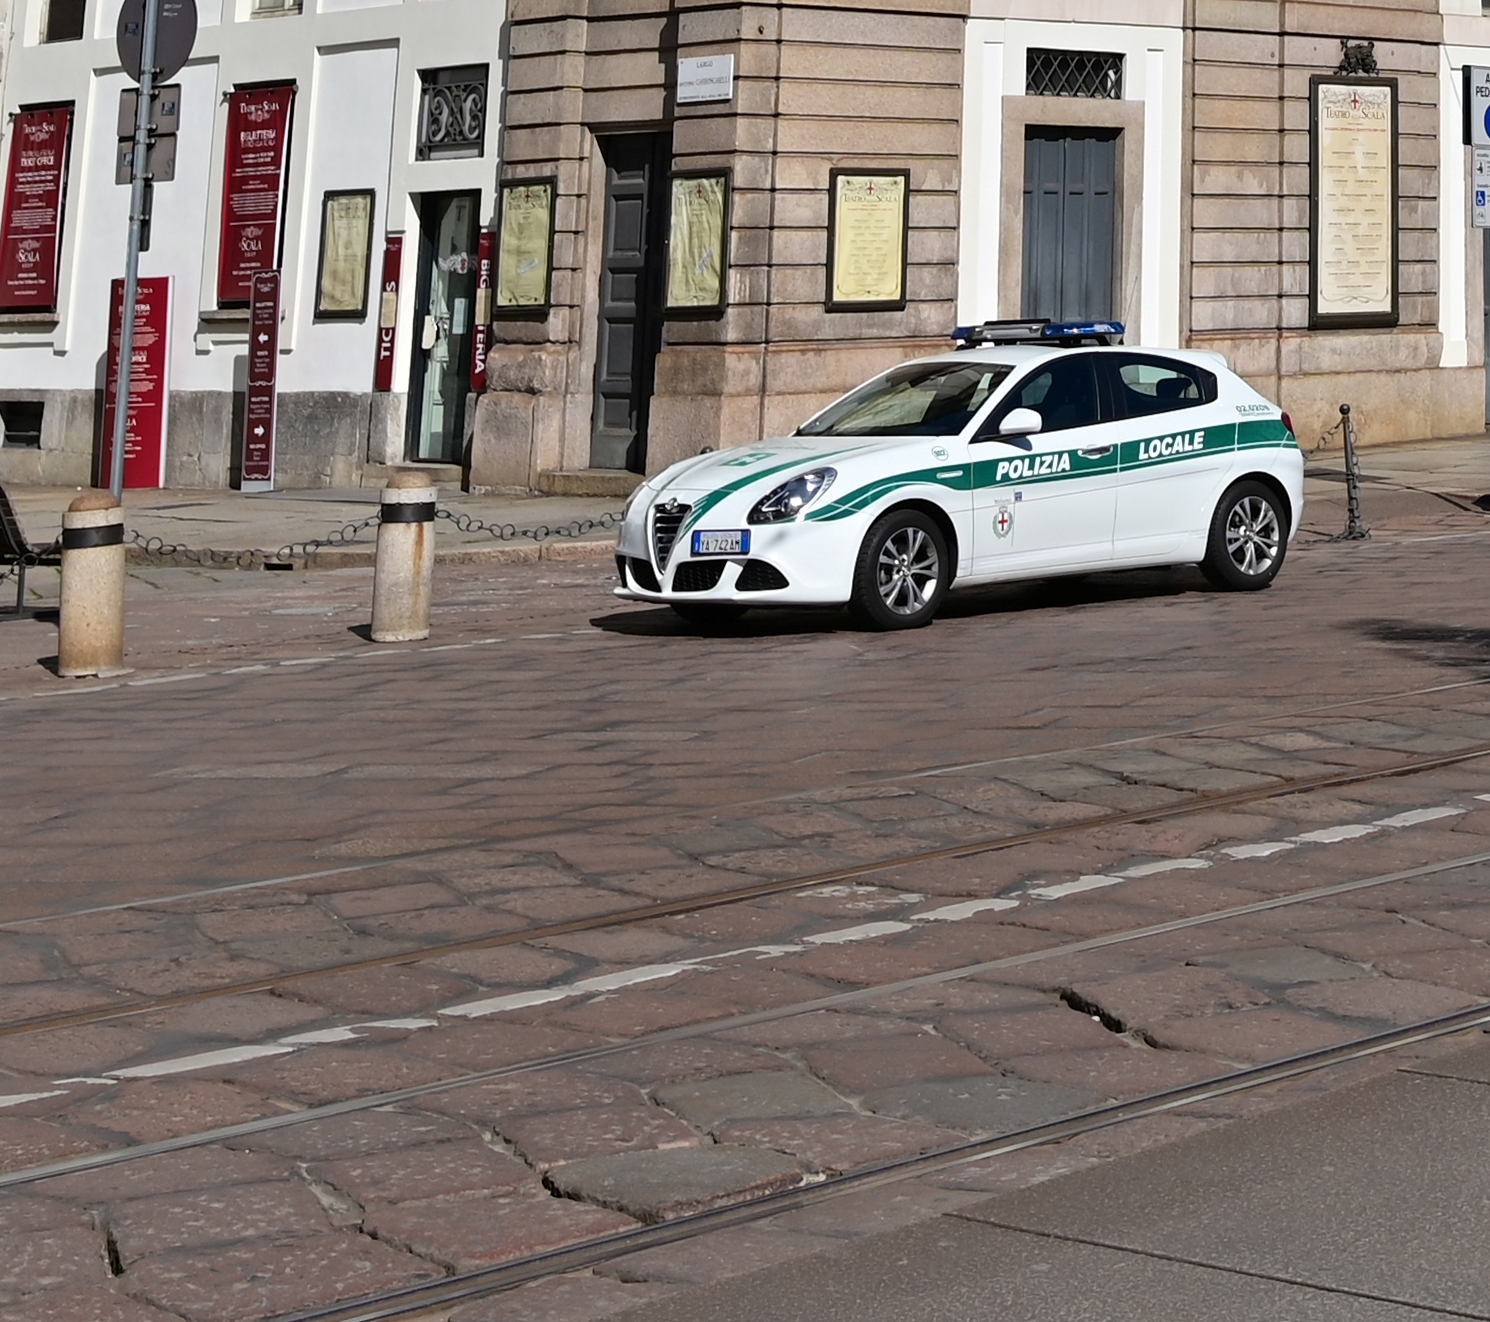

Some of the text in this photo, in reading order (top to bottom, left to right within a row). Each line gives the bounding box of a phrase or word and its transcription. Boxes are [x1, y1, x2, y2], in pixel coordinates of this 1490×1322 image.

[1325, 106, 1386, 120] TEATRO SCALA
[875, 194, 898, 203] SCALA
[995, 431, 1206, 481] POLIZIA LOCALE
